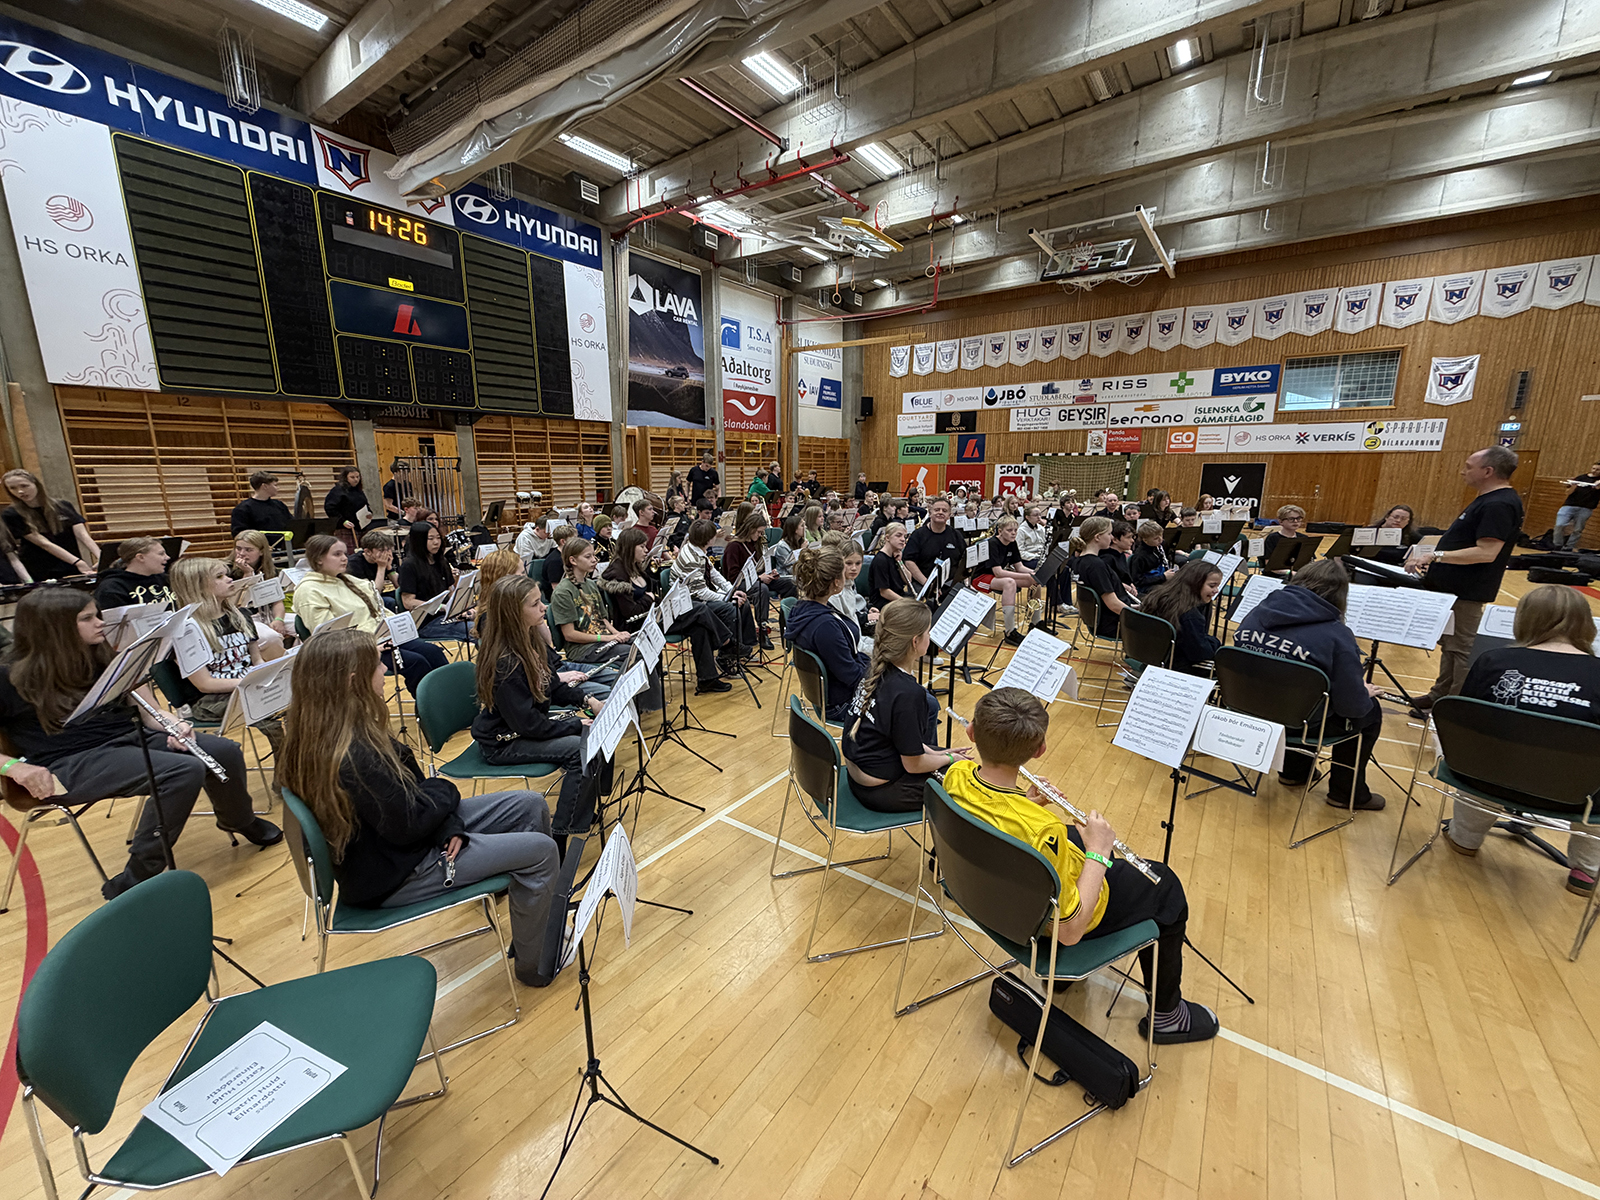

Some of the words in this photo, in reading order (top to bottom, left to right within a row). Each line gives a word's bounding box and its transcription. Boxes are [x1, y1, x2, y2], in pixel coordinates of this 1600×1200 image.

[103, 75, 309, 165] HYUNDAI
[369, 210, 427, 246] 14:26
[504, 209, 598, 257] HYUNDAI
[24, 235, 58, 255] HS
[65, 243, 129, 268] ORKA
[655, 288, 698, 321] LAVA
[747, 326, 772, 344] T.S.A
[571, 337, 583, 347] HS
[584, 341, 606, 351] ORKA
[721, 356, 772, 384] Aðaltorg
[1220, 370, 1272, 383] BYKO
[1102, 379, 1148, 391] RISS
[999, 386, 1026, 400] JBÓ
[177, 396, 190, 407] 12
[250, 401, 261, 411] 13
[914, 397, 933, 406] BLUE
[1016, 407, 1051, 418] HUG
[1058, 407, 1107, 422] GEYSIR
[1194, 406, 1240, 415] ÍSLENSKA
[723, 416, 771, 431] slandsbanki
[1110, 414, 1184, 425] serrano
[1193, 414, 1264, 424] GÁMAFÉLAGIÐ
[1171, 432, 1195, 443] GO
[1313, 431, 1356, 442] VERKÍS
[905, 445, 941, 454] LENGJAN
[1000, 465, 1035, 475] SPORT
[1241, 643, 1264, 653] ACTIVE
[1265, 649, 1286, 659] CLUB
[1520, 695, 1558, 708] 2026
[1211, 714, 1228, 722] Jakob
[1240, 721, 1266, 733] Emilsson
[258, 1075, 280, 1093] Huld
[212, 1087, 236, 1105] Huld
